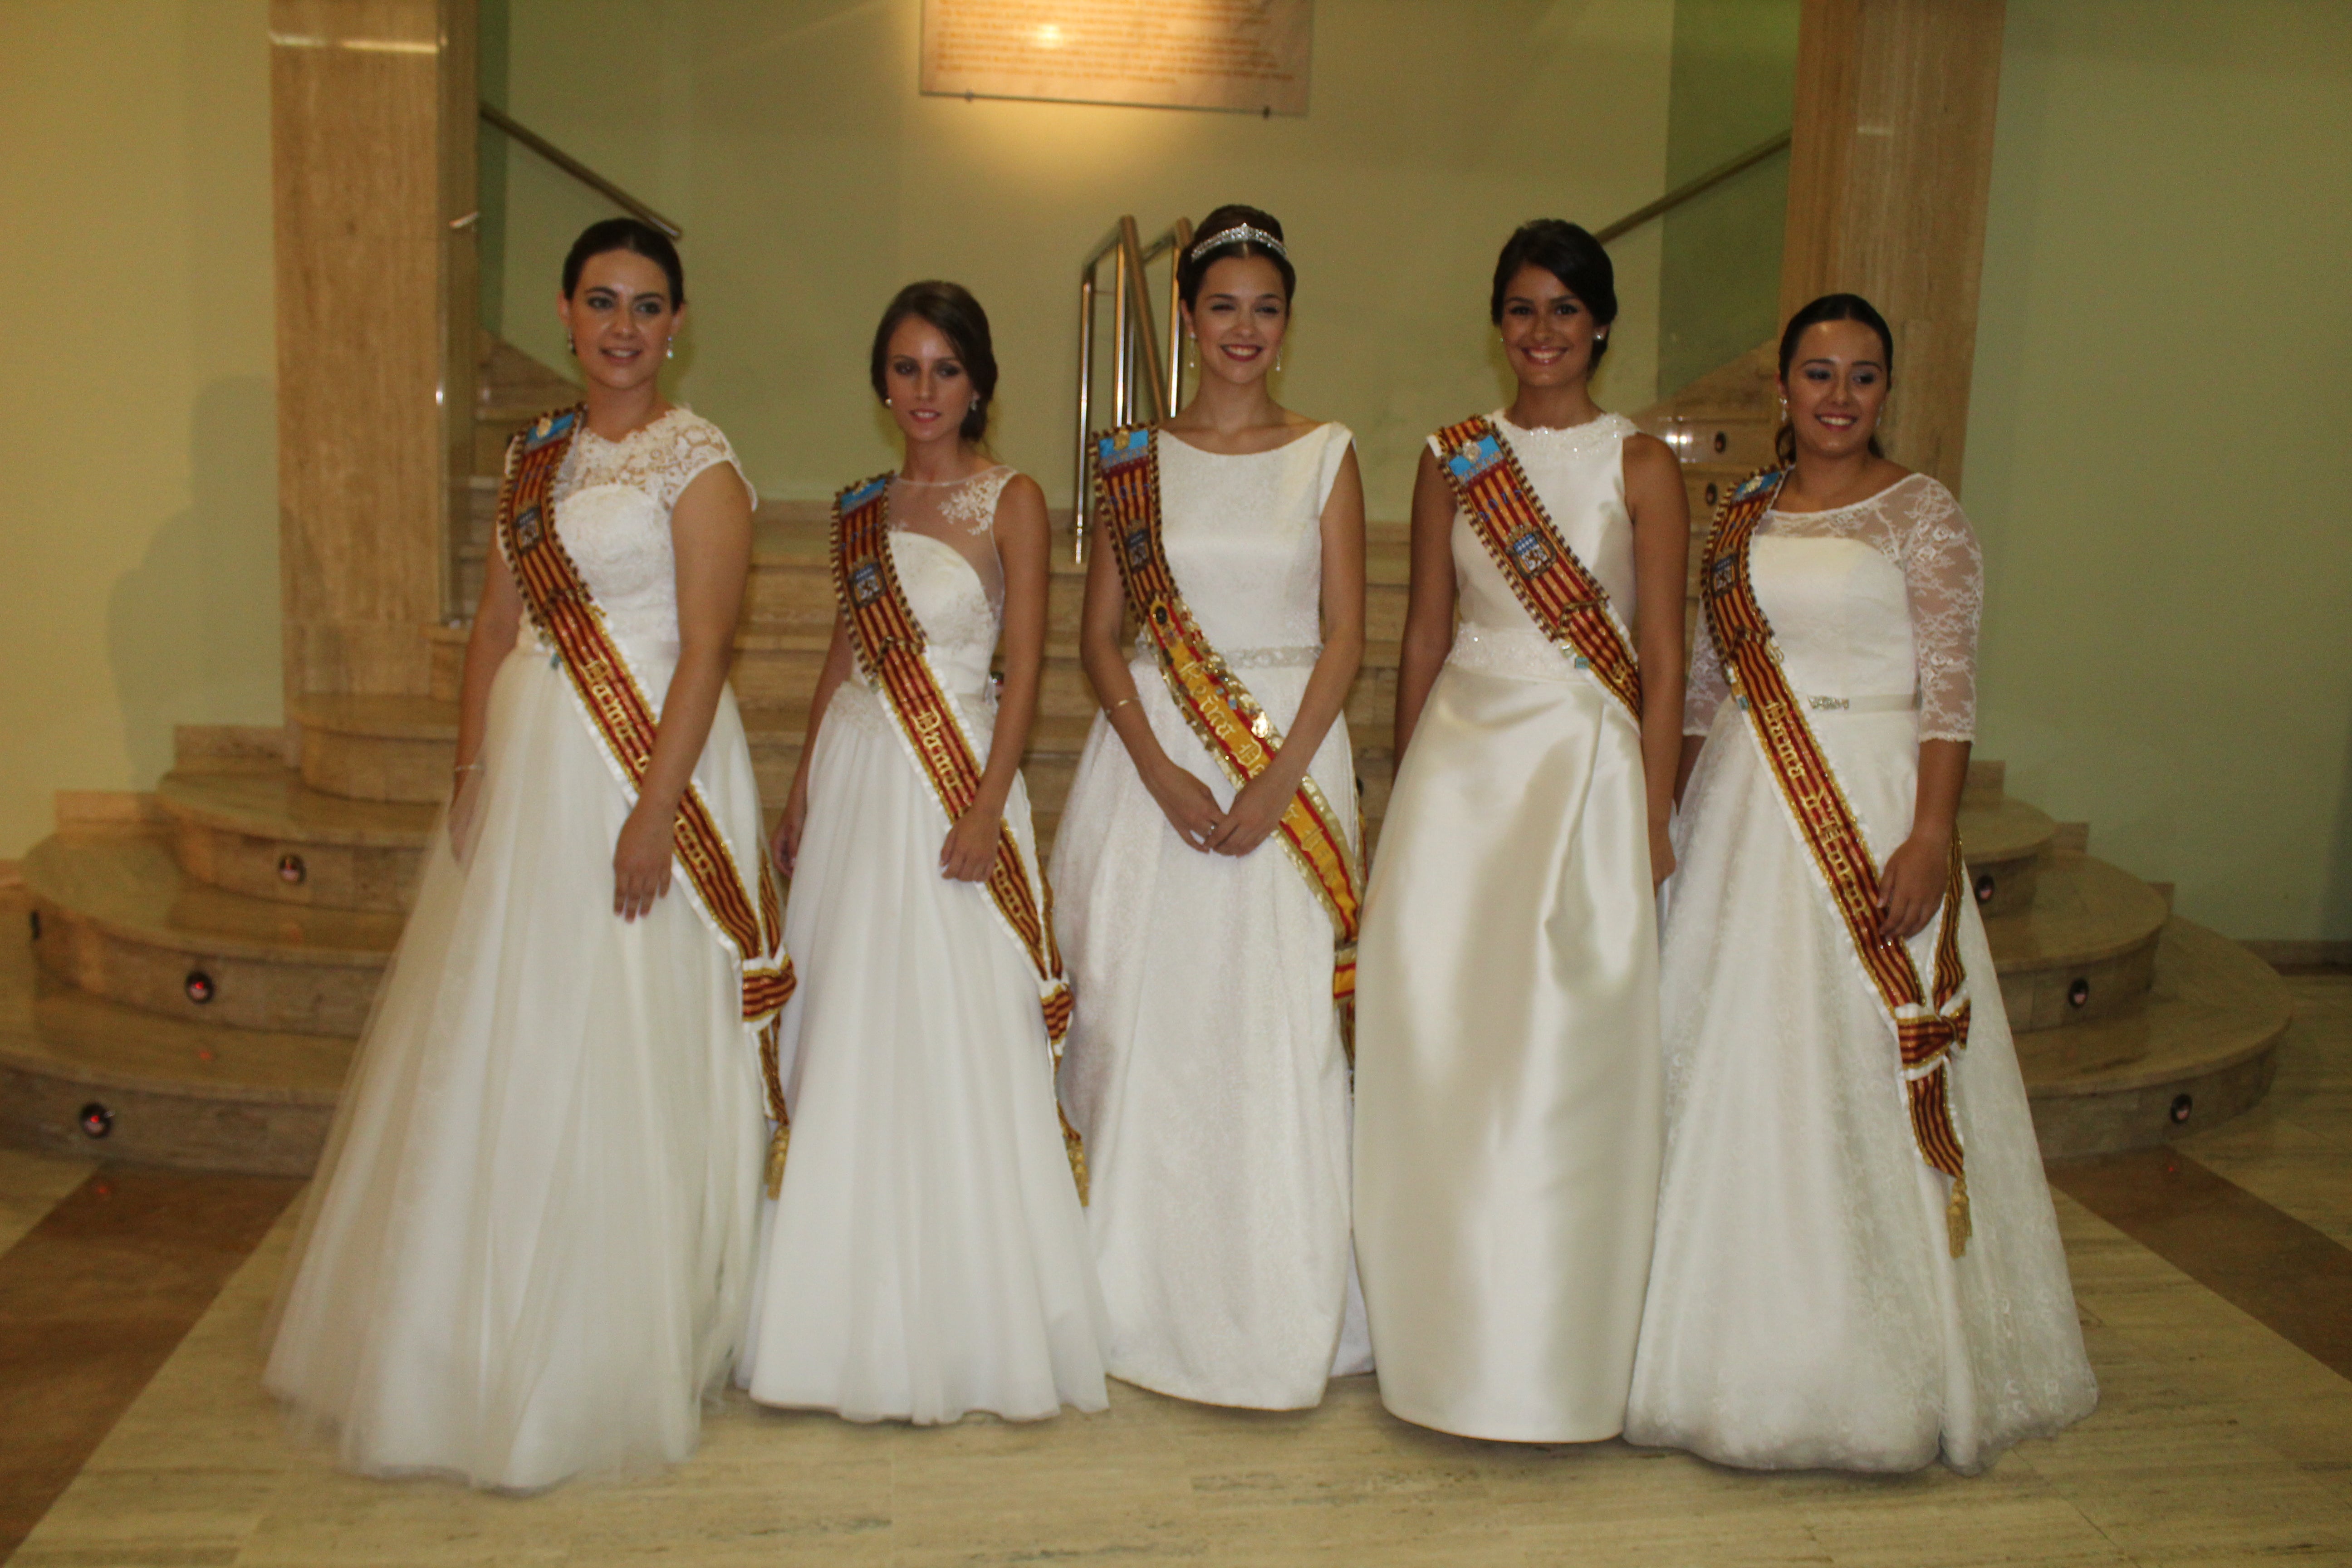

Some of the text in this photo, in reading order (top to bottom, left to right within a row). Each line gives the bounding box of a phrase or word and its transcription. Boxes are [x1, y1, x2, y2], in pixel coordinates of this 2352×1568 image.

[579, 652, 637, 740] Dama
[1764, 699, 1806, 779] Dama
[909, 702, 962, 790] Dama
